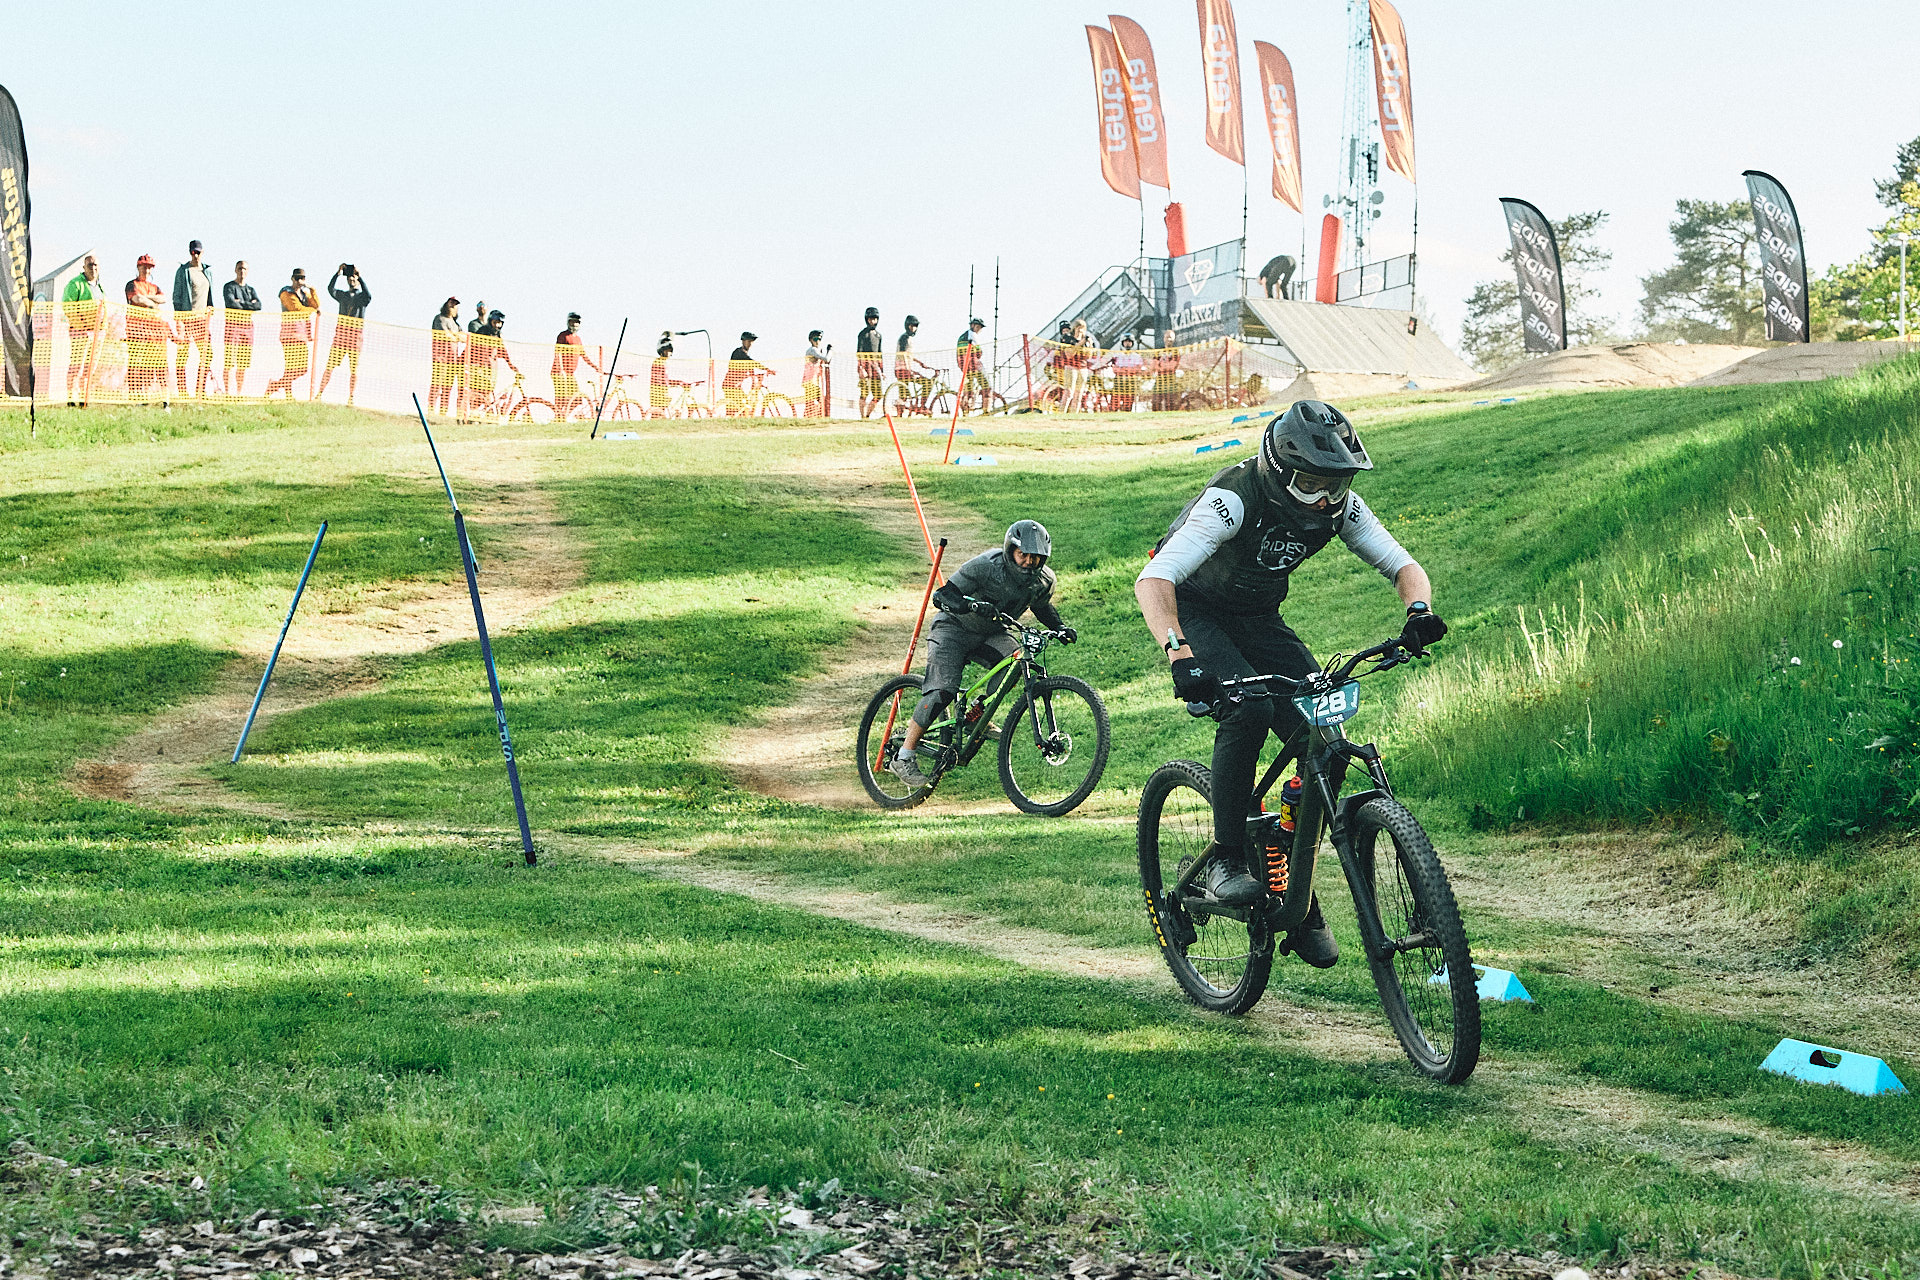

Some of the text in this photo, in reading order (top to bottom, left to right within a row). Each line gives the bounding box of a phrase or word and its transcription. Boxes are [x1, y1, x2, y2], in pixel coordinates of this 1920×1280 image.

[1263, 540, 1297, 555] RIDE
[1027, 635, 1041, 648] 32
[1312, 690, 1347, 718] 28
[1325, 713, 1345, 724] RIDE
